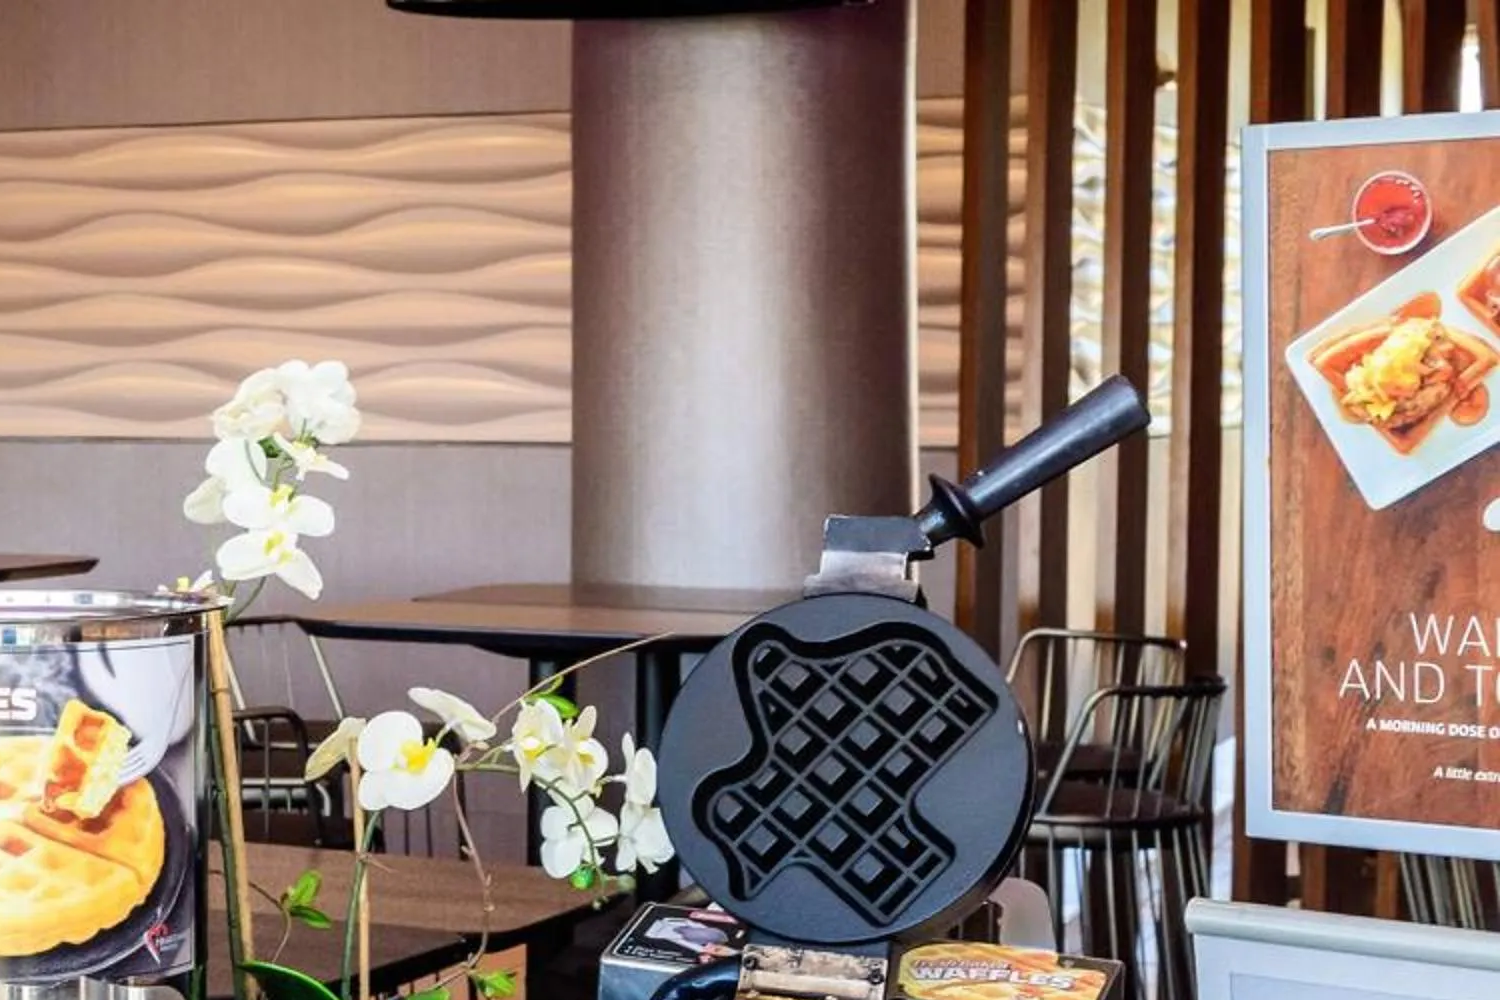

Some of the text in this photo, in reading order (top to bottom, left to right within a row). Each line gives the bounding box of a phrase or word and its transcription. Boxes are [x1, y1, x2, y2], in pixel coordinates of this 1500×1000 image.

[1338, 658, 1500, 708] AND T
[1365, 717, 1377, 731] A
[1379, 719, 1445, 736] MORNING
[1448, 723, 1487, 739] DOSE
[1433, 765, 1443, 778] A
[911, 966, 1076, 990] WAFFLES
